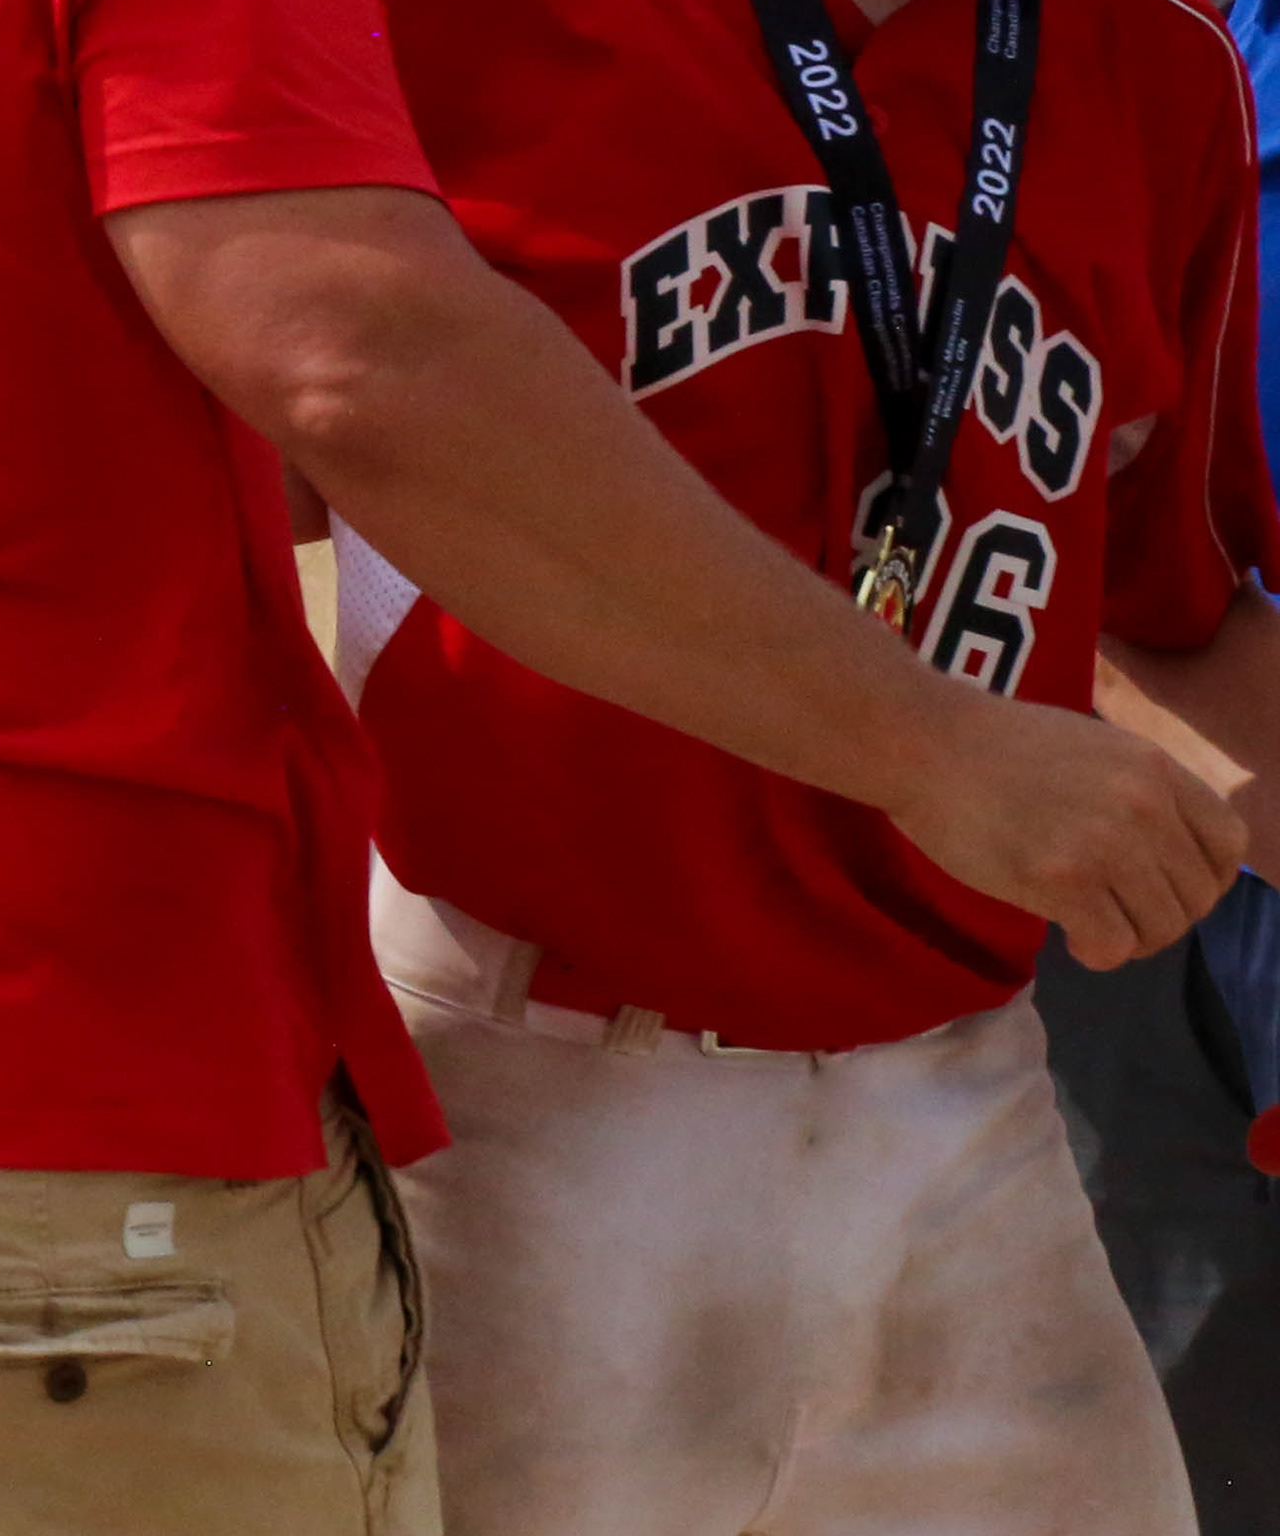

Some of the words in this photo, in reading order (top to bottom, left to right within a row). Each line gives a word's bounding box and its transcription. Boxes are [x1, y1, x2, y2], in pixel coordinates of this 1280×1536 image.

[788, 39, 859, 140] 2022
[972, 117, 1016, 224] 2022
[851, 205, 877, 276] Canadian
